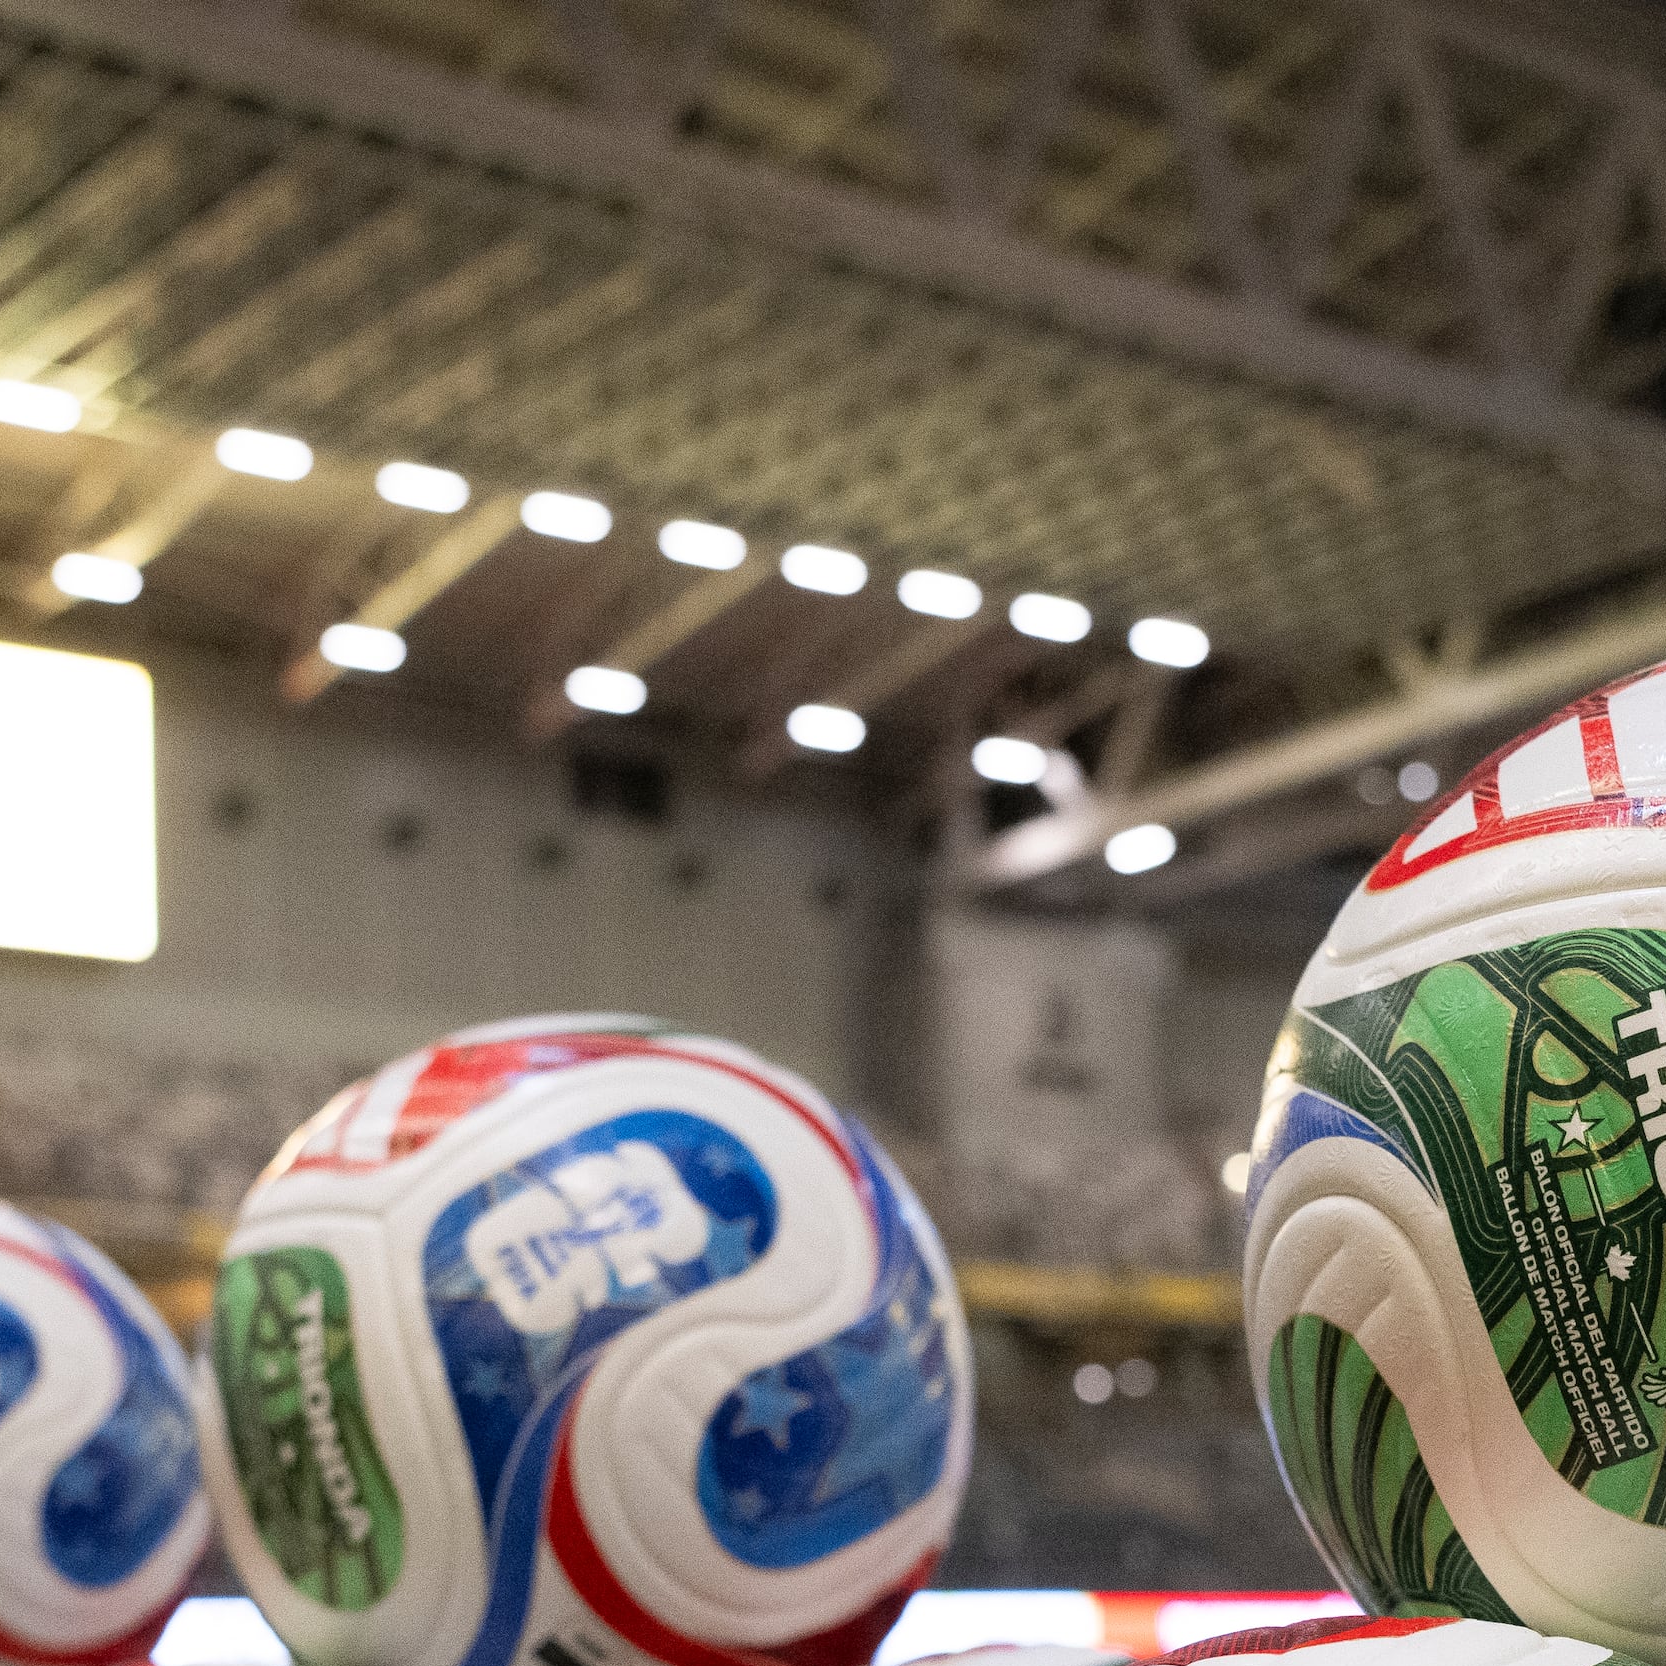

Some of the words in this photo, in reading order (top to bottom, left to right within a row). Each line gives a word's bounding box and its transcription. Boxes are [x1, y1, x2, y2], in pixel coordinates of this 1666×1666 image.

[1495, 1166, 1532, 1254] BALLON
[1522, 1255, 1543, 1286] DE
[1533, 1287, 1569, 1368] MATCH
[1562, 1369, 1607, 1465] OFFICIEL
[1532, 1216, 1567, 1318] OFFICIAL
[1564, 1318, 1604, 1400] MATCH
[1594, 1402, 1627, 1458] BALL
[1553, 1225, 1587, 1312] OFICIAL
[1583, 1312, 1607, 1356] DEL
[1600, 1357, 1649, 1450] PARTIDO
